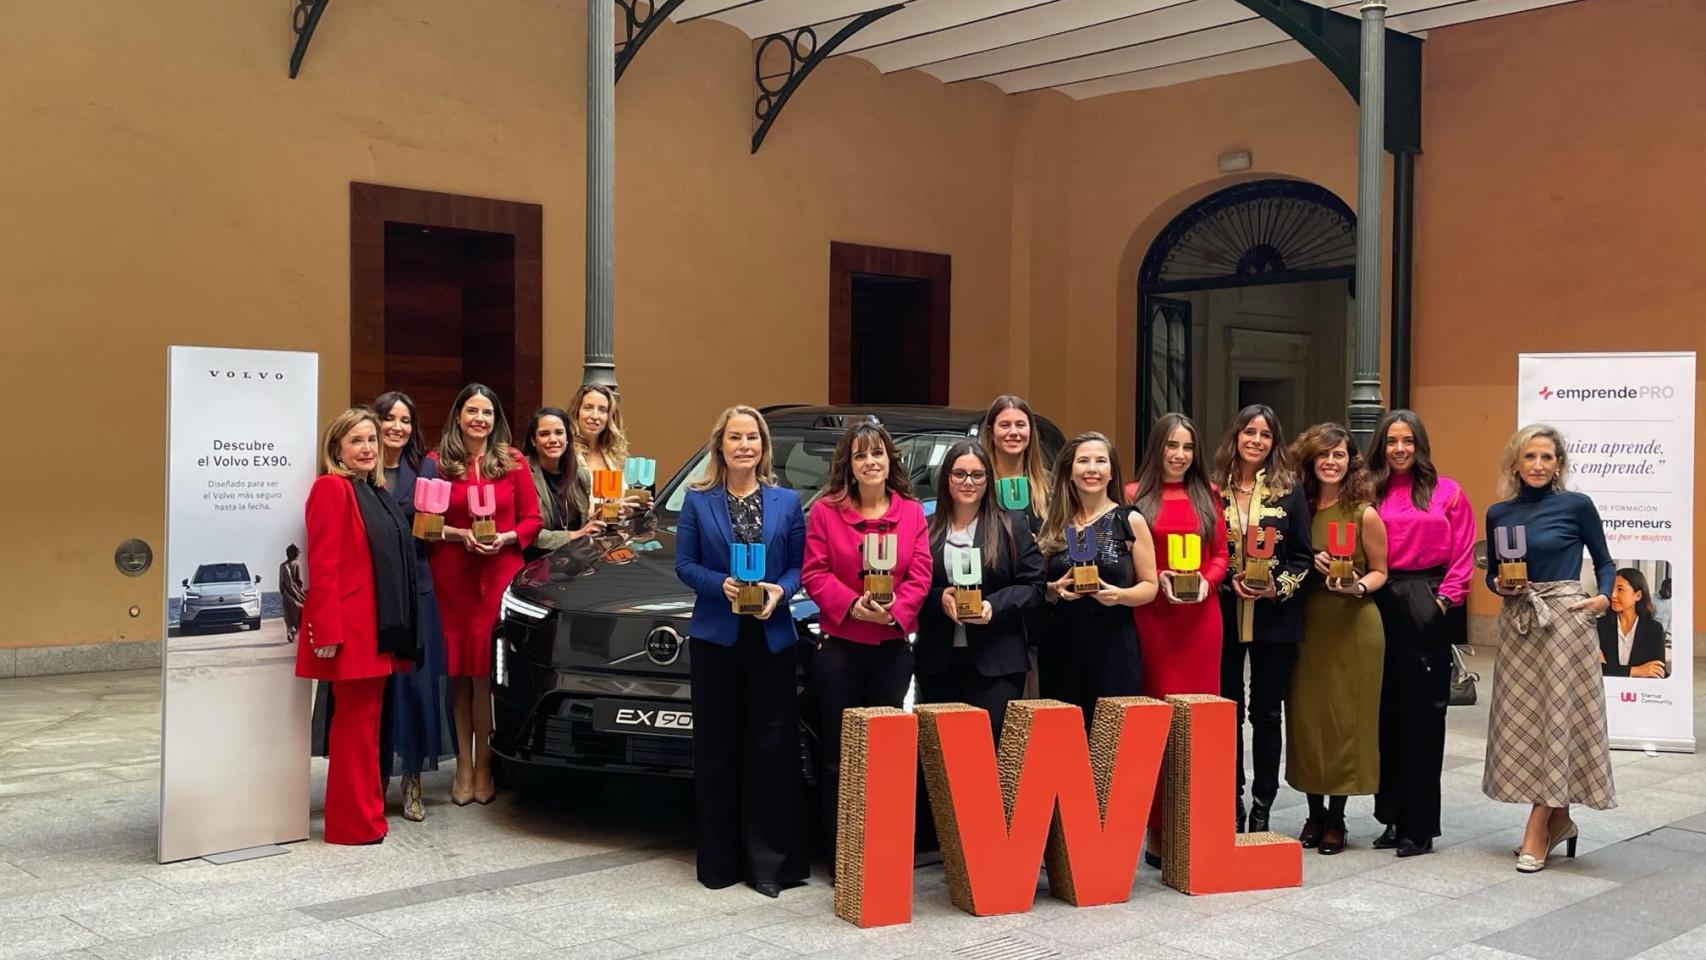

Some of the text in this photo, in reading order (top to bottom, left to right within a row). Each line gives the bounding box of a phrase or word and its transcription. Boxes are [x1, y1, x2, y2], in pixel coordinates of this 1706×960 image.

[209, 370, 284, 380] VOLVO
[213, 439, 275, 451] Descubre
[1564, 439, 1597, 454] uien
[197, 455, 292, 467] el Volvo EX90.
[208, 480, 245, 488] Diseñado
[247, 481, 265, 490] para
[203, 492, 282, 501] el Volvo más seguro
[215, 502, 271, 511] hasta la fecha.
[1601, 519, 1672, 531] mpreneurs
[834, 693, 1304, 929] IWL
